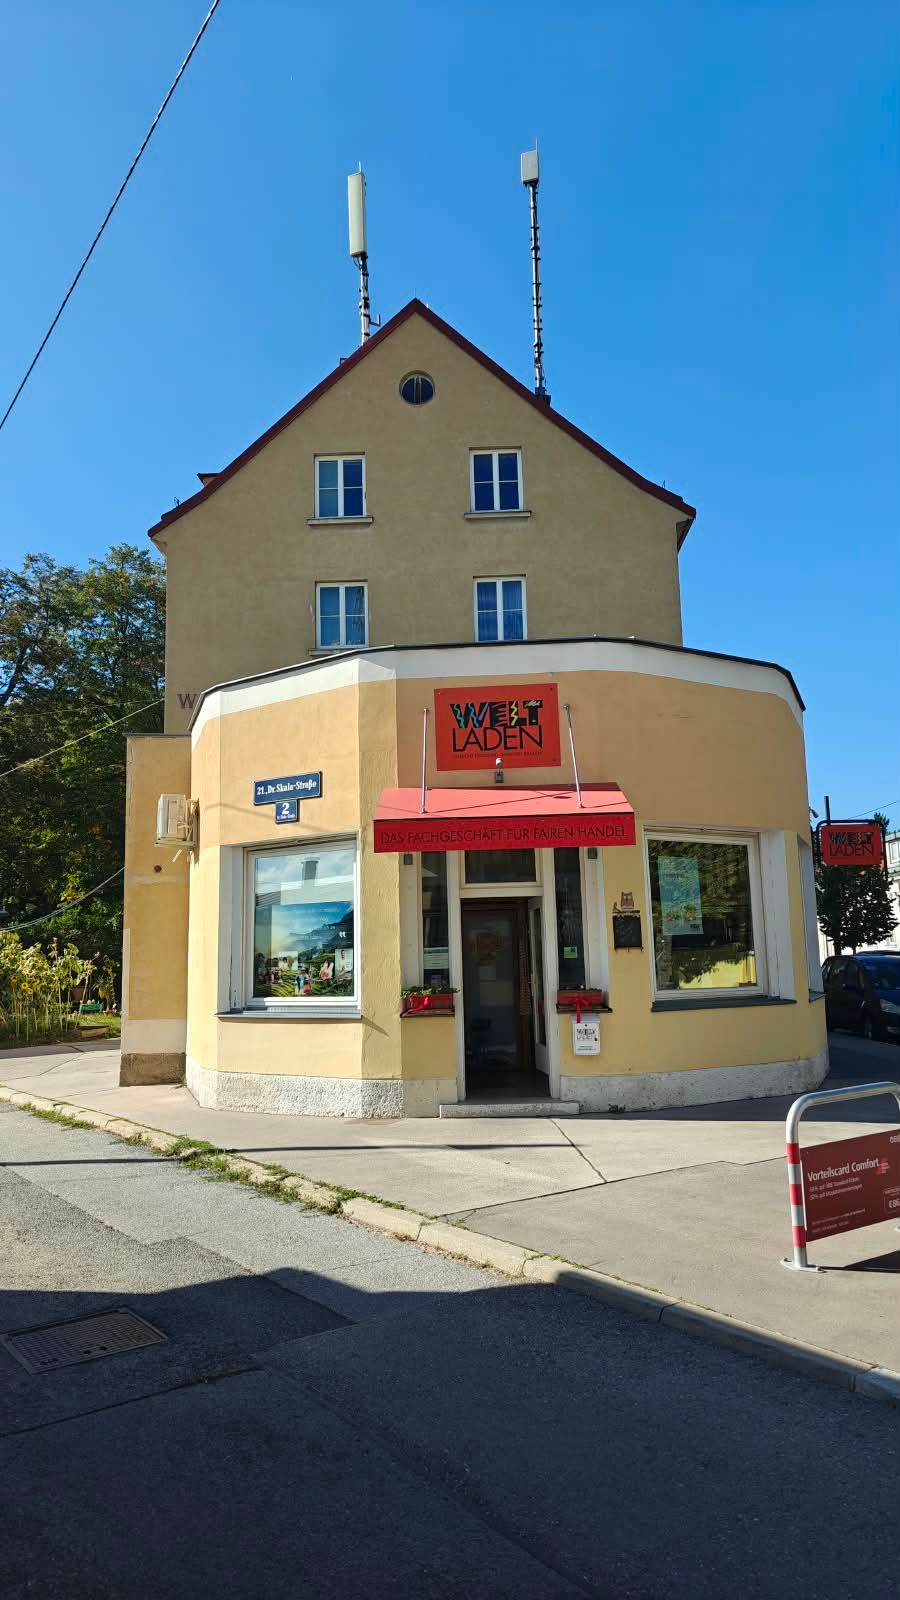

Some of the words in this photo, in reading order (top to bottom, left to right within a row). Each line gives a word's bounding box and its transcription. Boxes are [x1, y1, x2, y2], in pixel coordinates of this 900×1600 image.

[450, 700, 543, 729] WELT
[452, 725, 543, 753] LADEN
[281, 802, 290, 815] 2
[380, 831, 403, 844] DAS
[407, 826, 504, 844] FACHGESCHÄFT
[507, 826, 530, 840] FÜR
[534, 827, 574, 839] FAIREN
[579, 824, 628, 837] HANDEL
[829, 831, 875, 846] WELT
[829, 843, 875, 857] LADEN
[808, 1164, 850, 1182] Vorteilscard
[851, 1158, 879, 1172] Comfort
